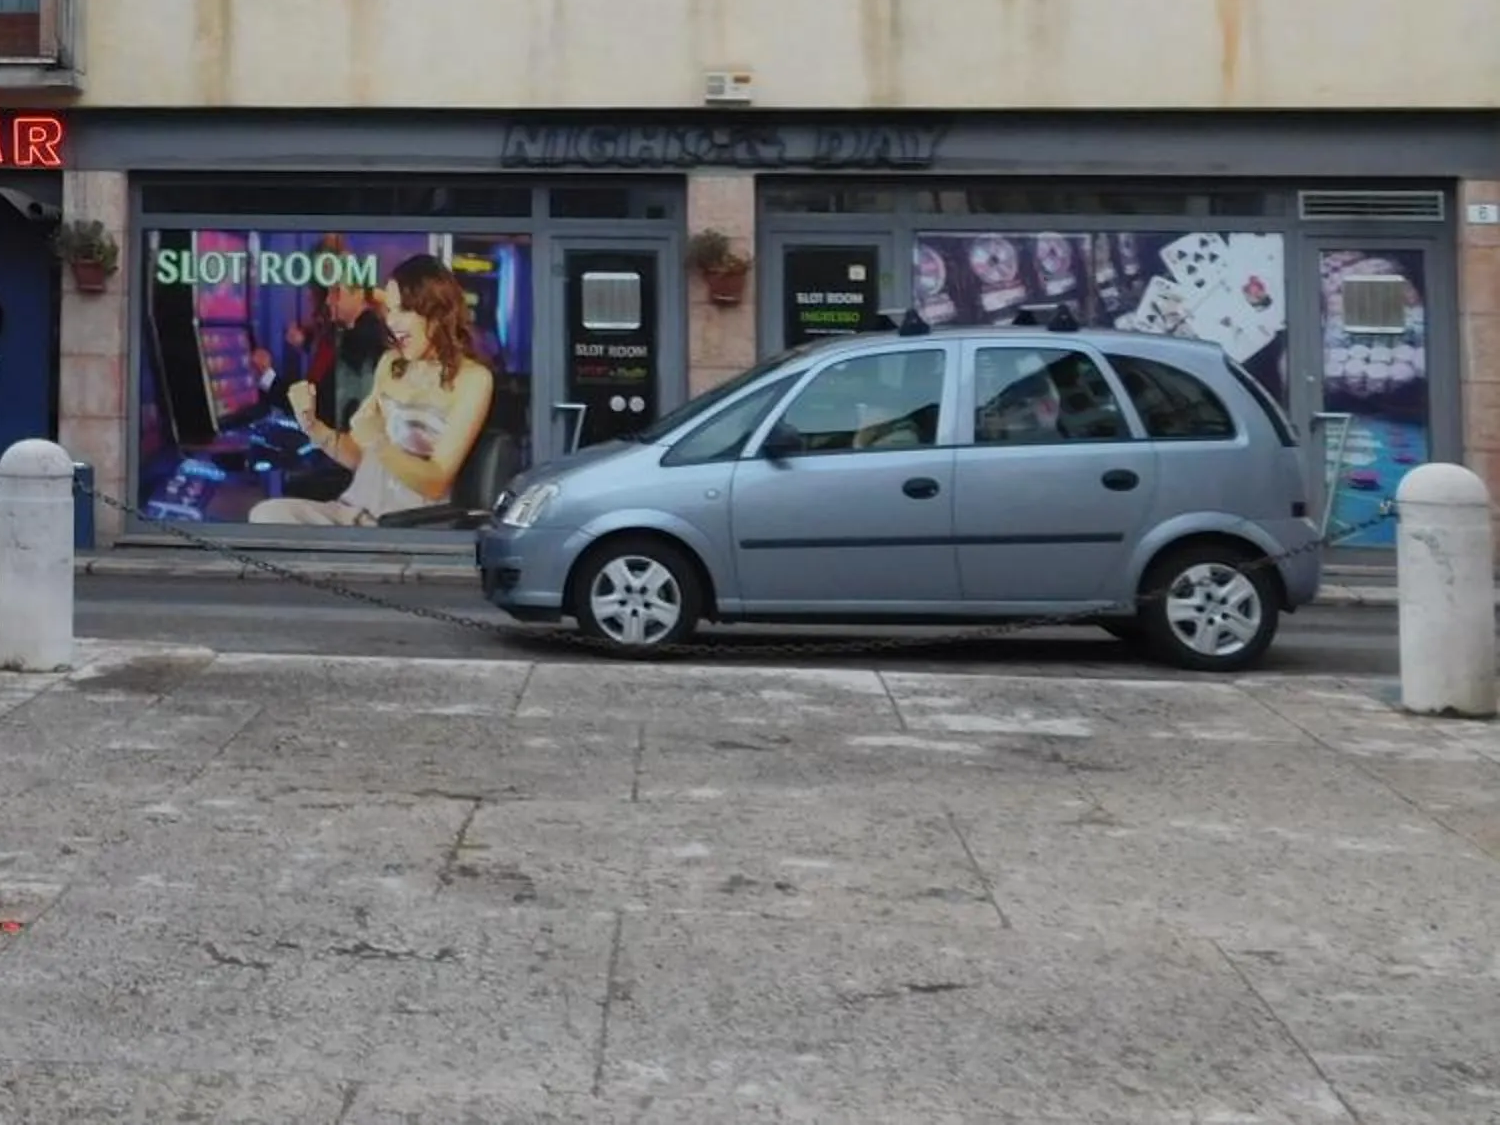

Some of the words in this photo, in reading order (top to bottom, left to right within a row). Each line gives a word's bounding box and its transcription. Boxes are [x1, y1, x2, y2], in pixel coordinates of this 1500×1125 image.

[156, 248, 247, 285] SLOT
[259, 250, 378, 287] ROOM
[796, 292, 823, 304] SLOT
[826, 292, 864, 304] ROOM
[575, 344, 603, 356] SLOT
[608, 345, 648, 357] ROOM
